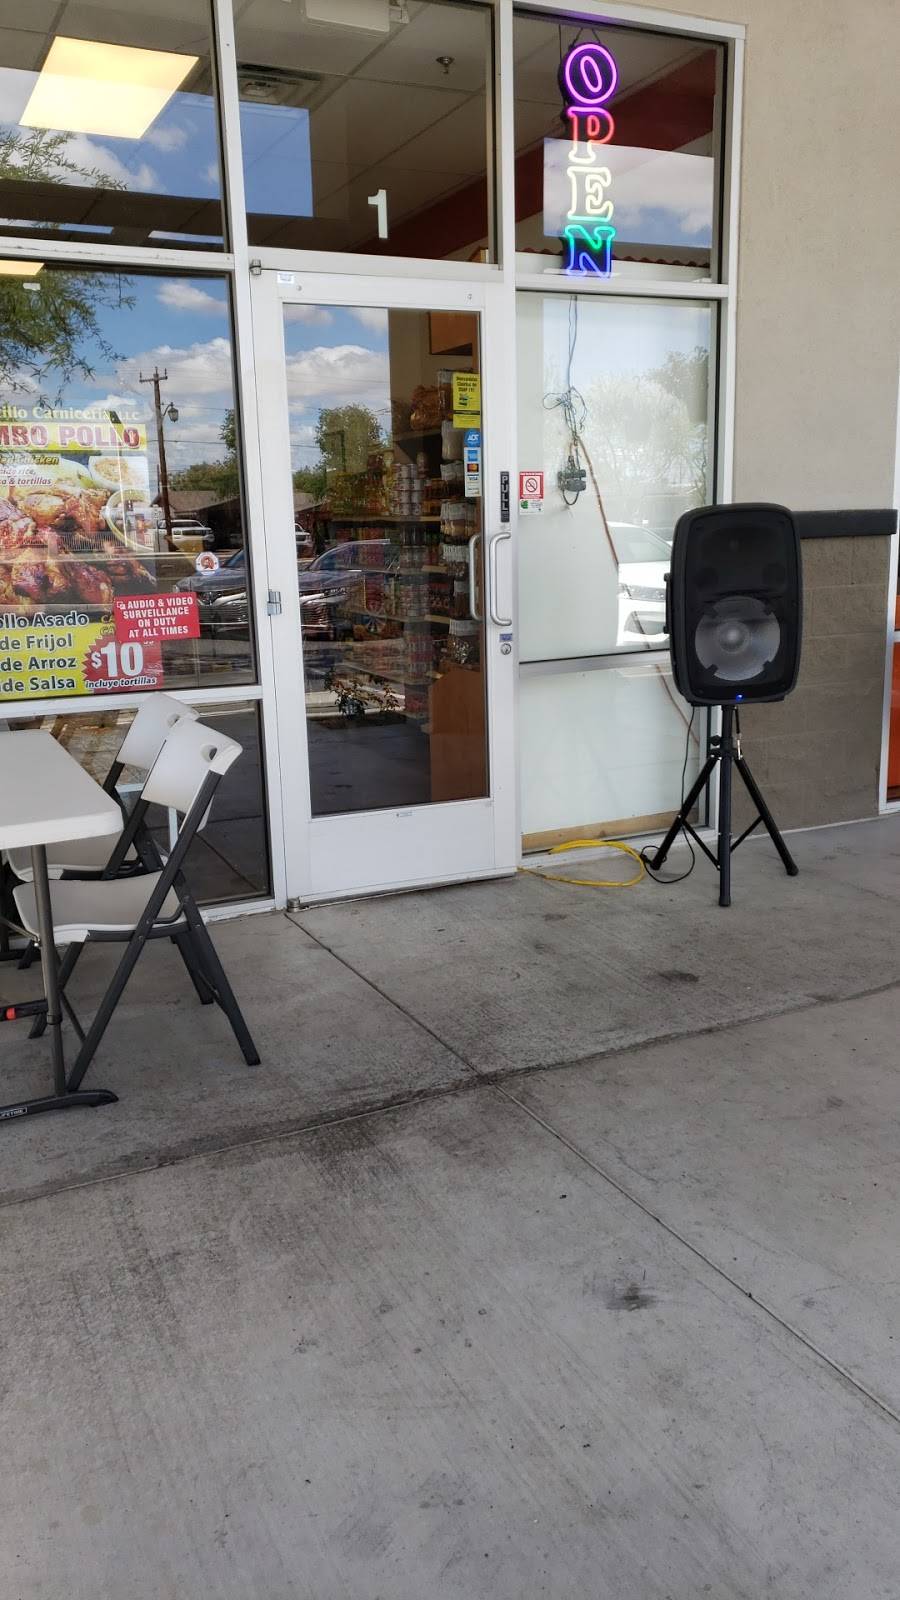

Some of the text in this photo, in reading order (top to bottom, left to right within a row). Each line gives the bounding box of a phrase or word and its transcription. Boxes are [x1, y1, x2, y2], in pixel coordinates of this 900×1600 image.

[564, 42, 618, 279] OPEN
[367, 189, 388, 239] 1
[0, 405, 28, 419] illo
[59, 425, 140, 448] POLLO
[17, 476, 52, 485] tortillas
[128, 597, 193, 609] AUDIO & VIDEO
[33, 611, 89, 627] Asado
[123, 607, 189, 619] SURVEILLANCE
[138, 617, 176, 628] ON DUTY
[129, 626, 189, 638] AT ALL TIMES
[0, 633, 72, 651] de Frijol
[0, 656, 77, 671] de Arroz
[91, 642, 144, 678] $10
[2, 676, 75, 692] de Salsa
[86, 676, 156, 689] incluye tortillas
